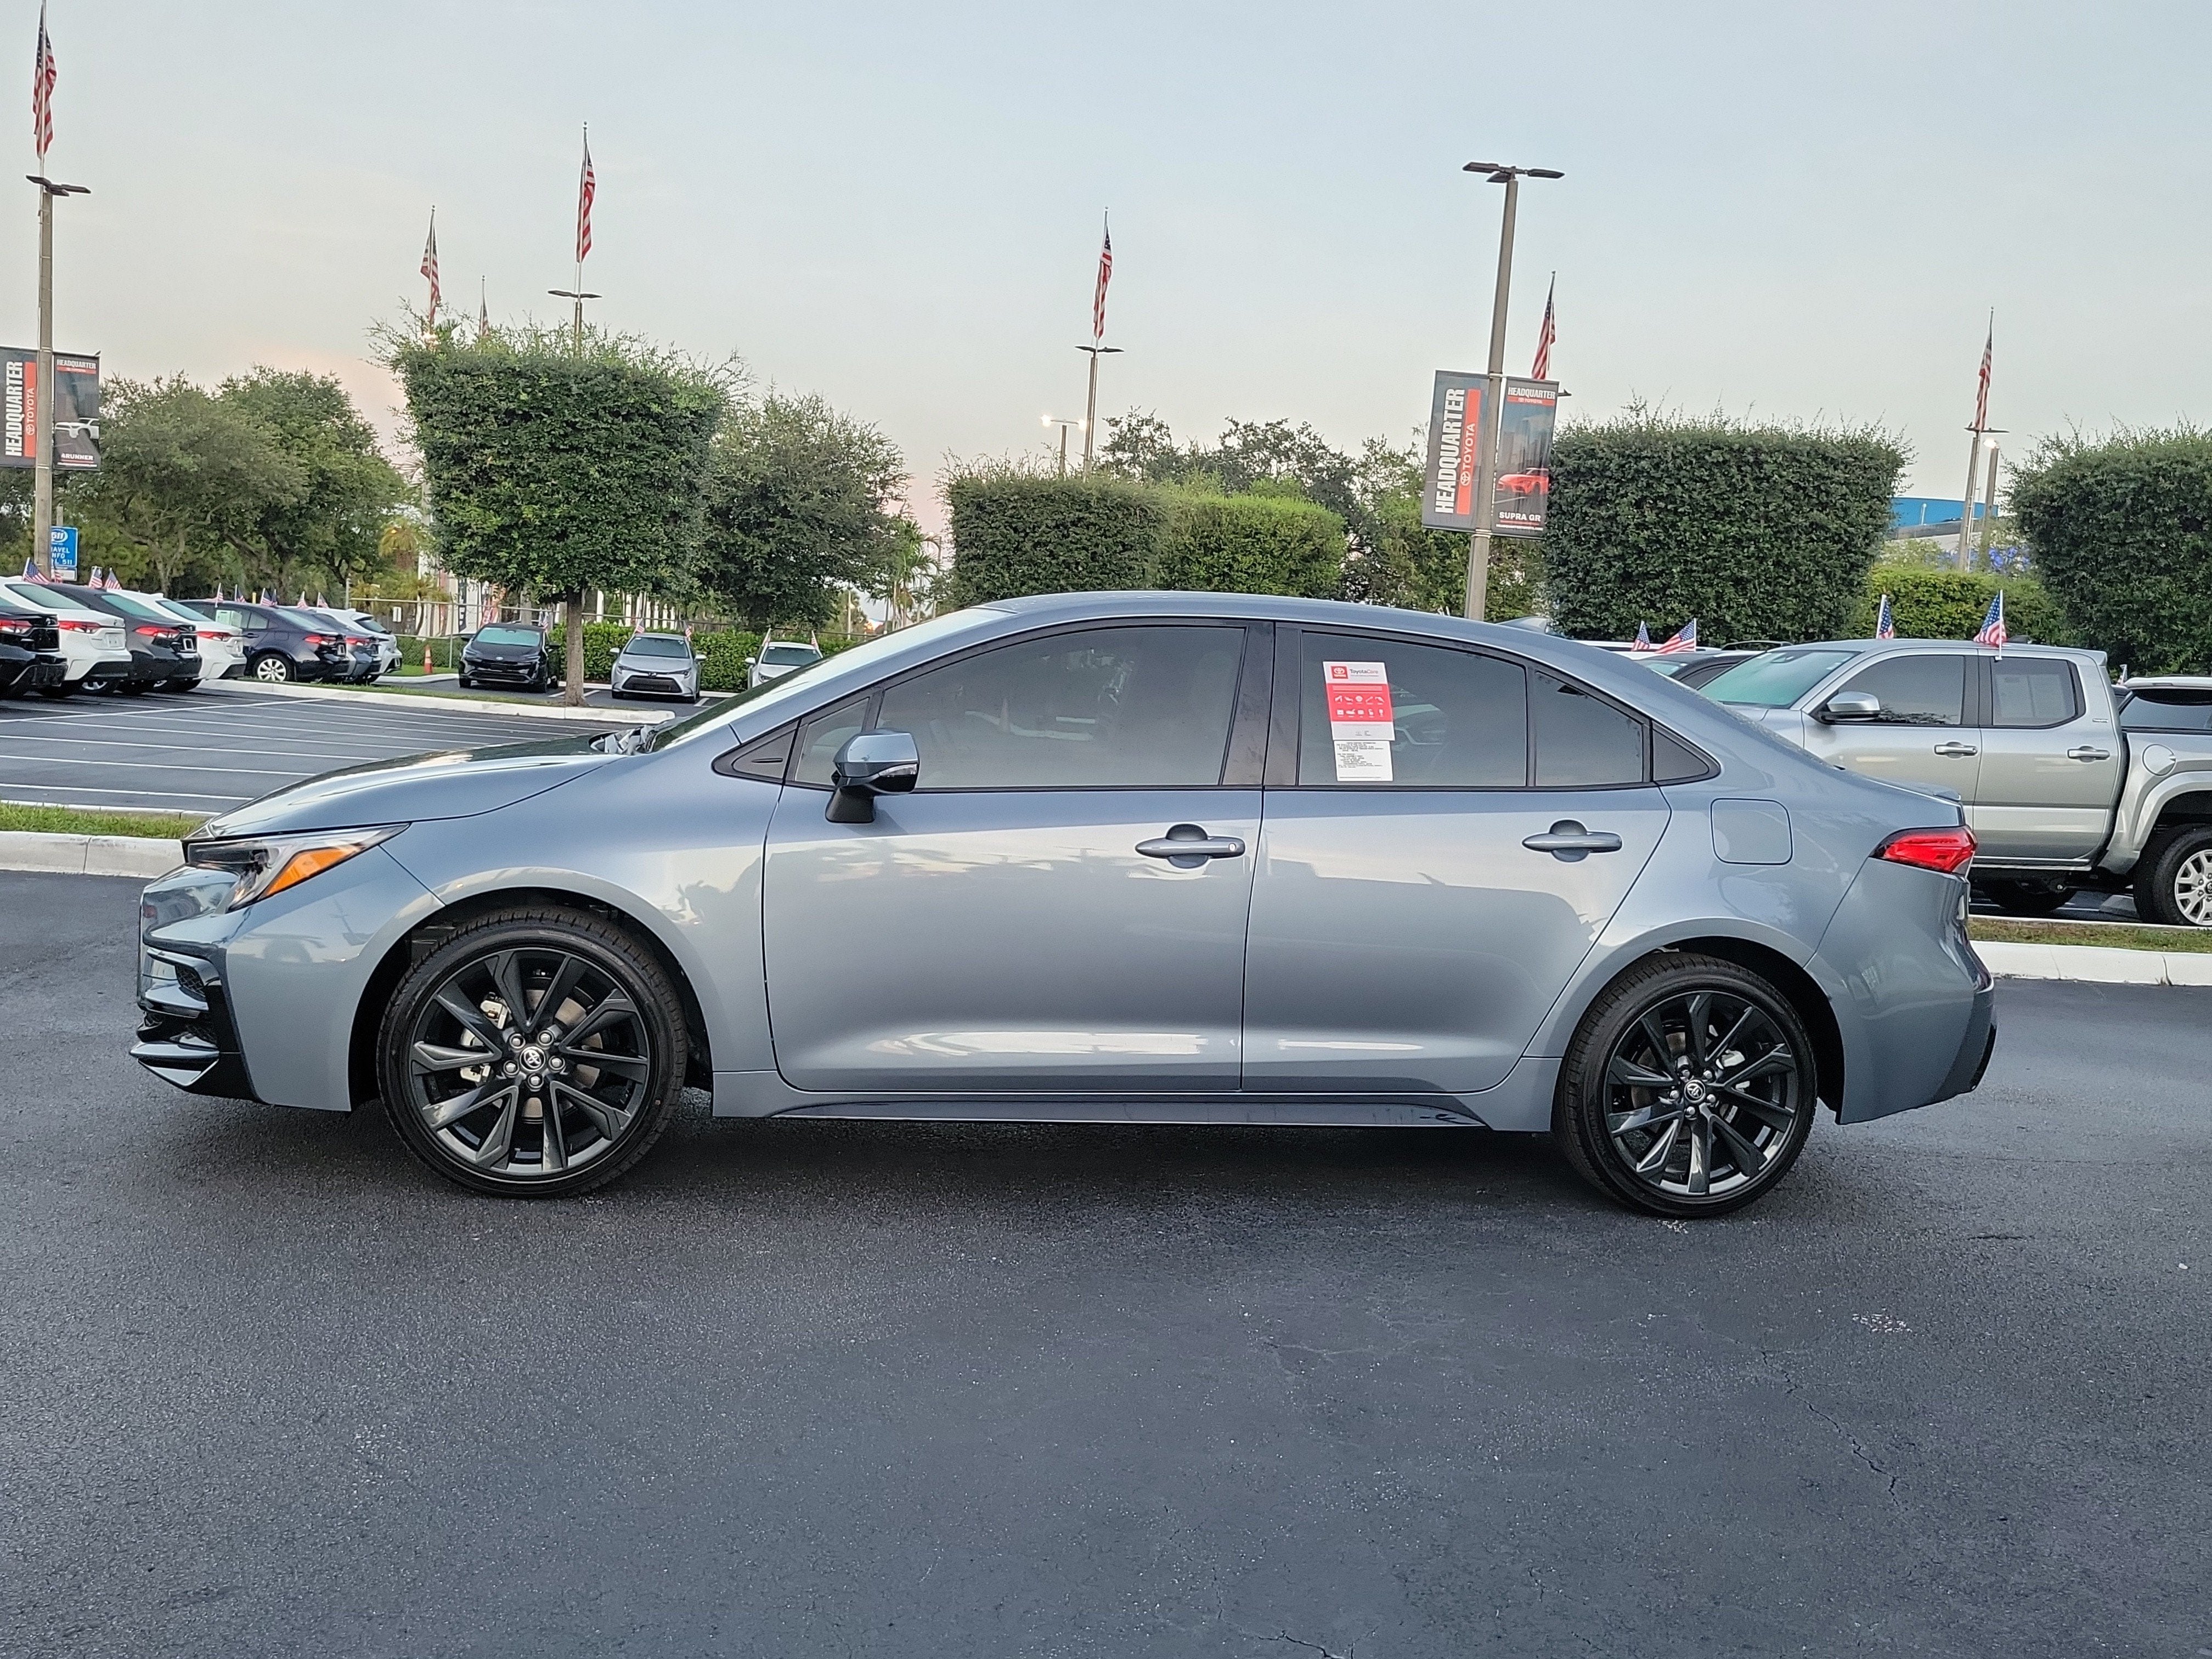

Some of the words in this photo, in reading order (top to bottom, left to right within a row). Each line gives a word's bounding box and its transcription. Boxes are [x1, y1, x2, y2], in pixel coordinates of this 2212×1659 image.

[57, 359, 96, 369] HEADQUARTER
[1508, 387, 1555, 399] HEADQUARTER
[5, 361, 25, 456] HEADQUARTER
[1435, 388, 1465, 514] HEADQUARTER
[1462, 423, 1476, 471] TOYOTA
[1499, 511, 1527, 521] SUPRA
